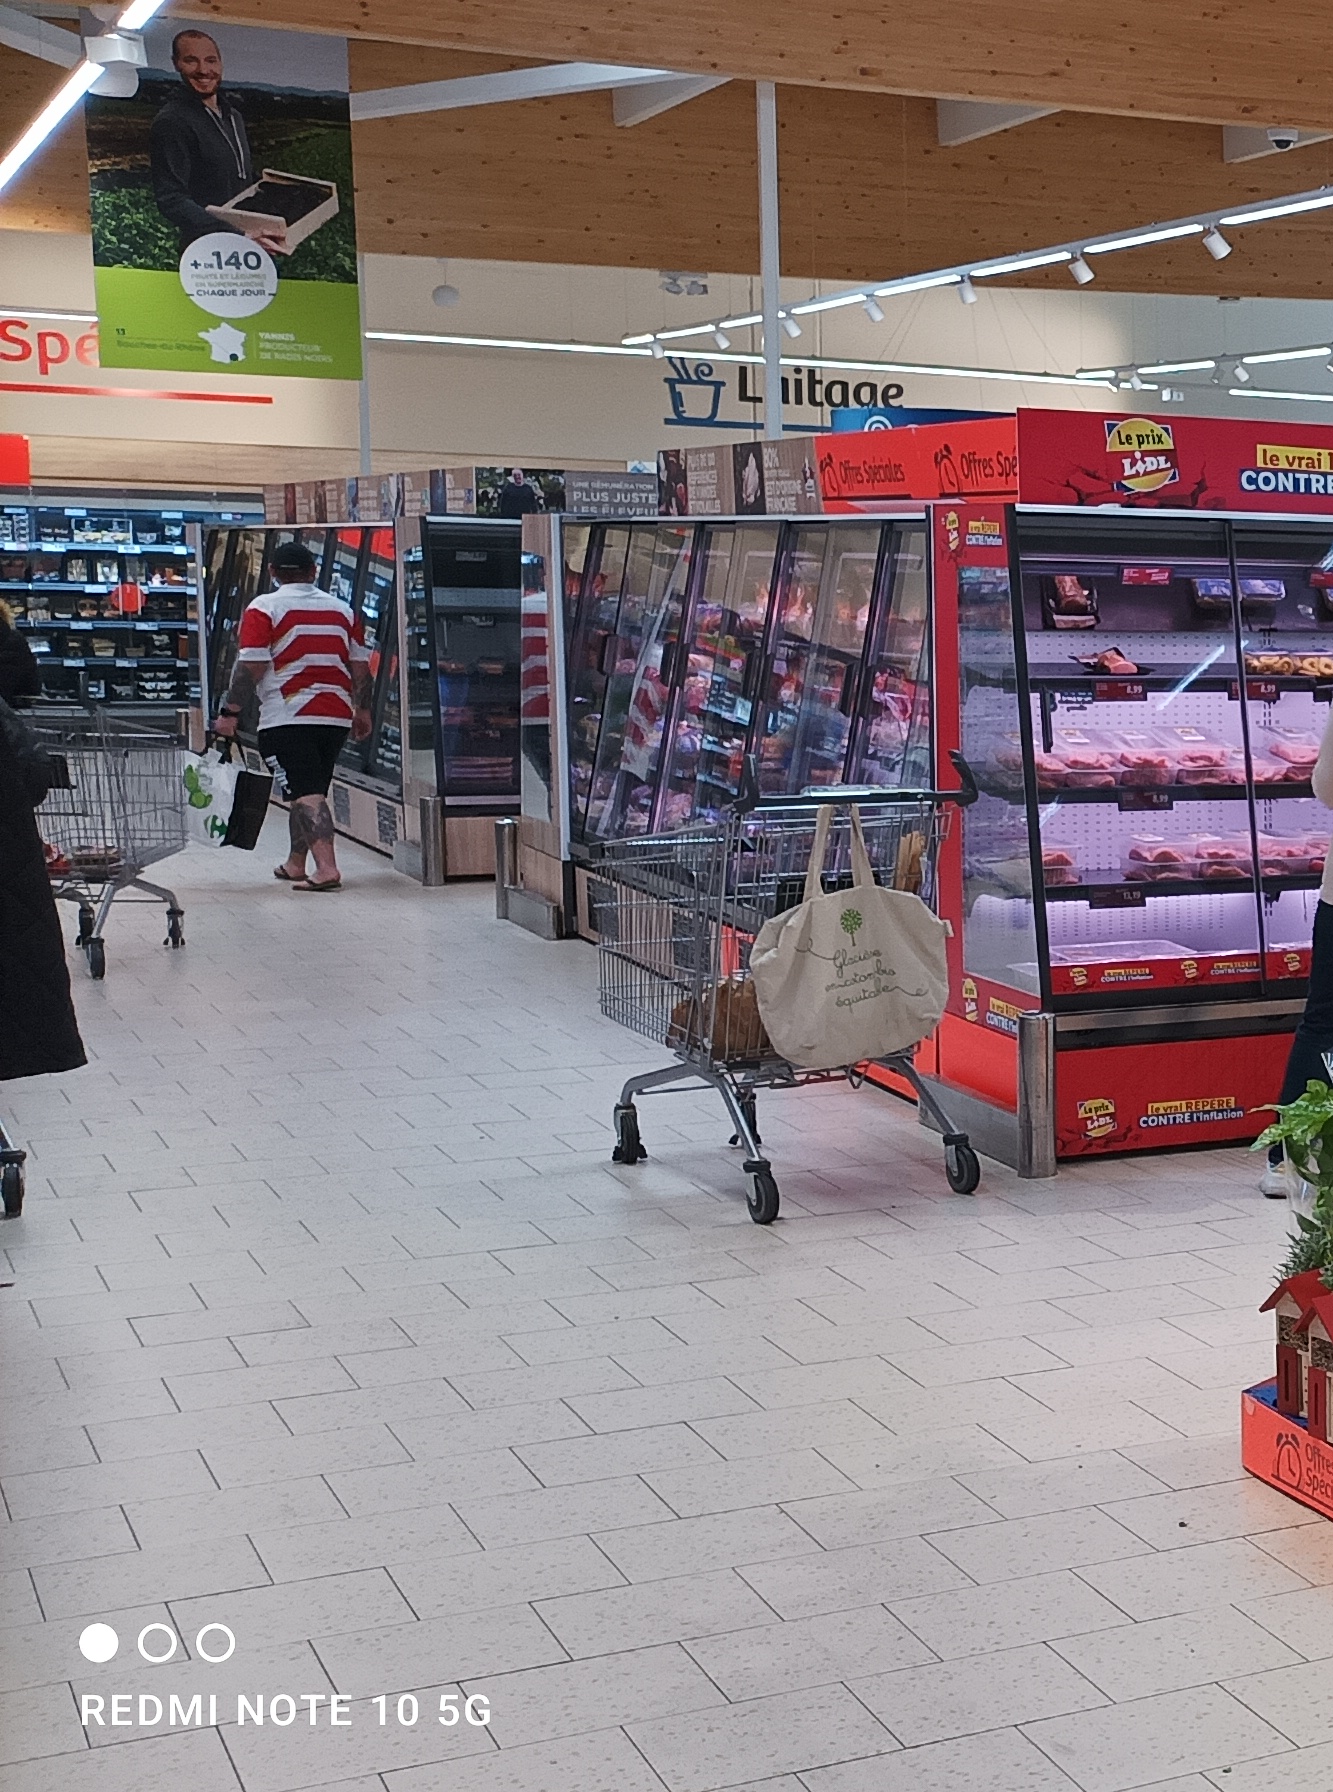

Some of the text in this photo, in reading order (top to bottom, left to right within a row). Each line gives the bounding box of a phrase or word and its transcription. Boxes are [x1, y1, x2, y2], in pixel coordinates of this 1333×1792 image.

[211, 250, 263, 271] 140
[196, 289, 267, 297] CHAQUE JOUR
[1117, 429, 1165, 452] Le prix
[960, 451, 994, 487] Offres
[1260, 449, 1281, 469] le
[1284, 453, 1324, 471] vrai
[839, 456, 906, 492] Offres Spéciales
[573, 491, 658, 504] PLUS JUSTE
[1150, 1104, 1160, 1113] le
[1163, 1103, 1182, 1113] vrai
[1139, 1113, 1191, 1127] CONTRE
